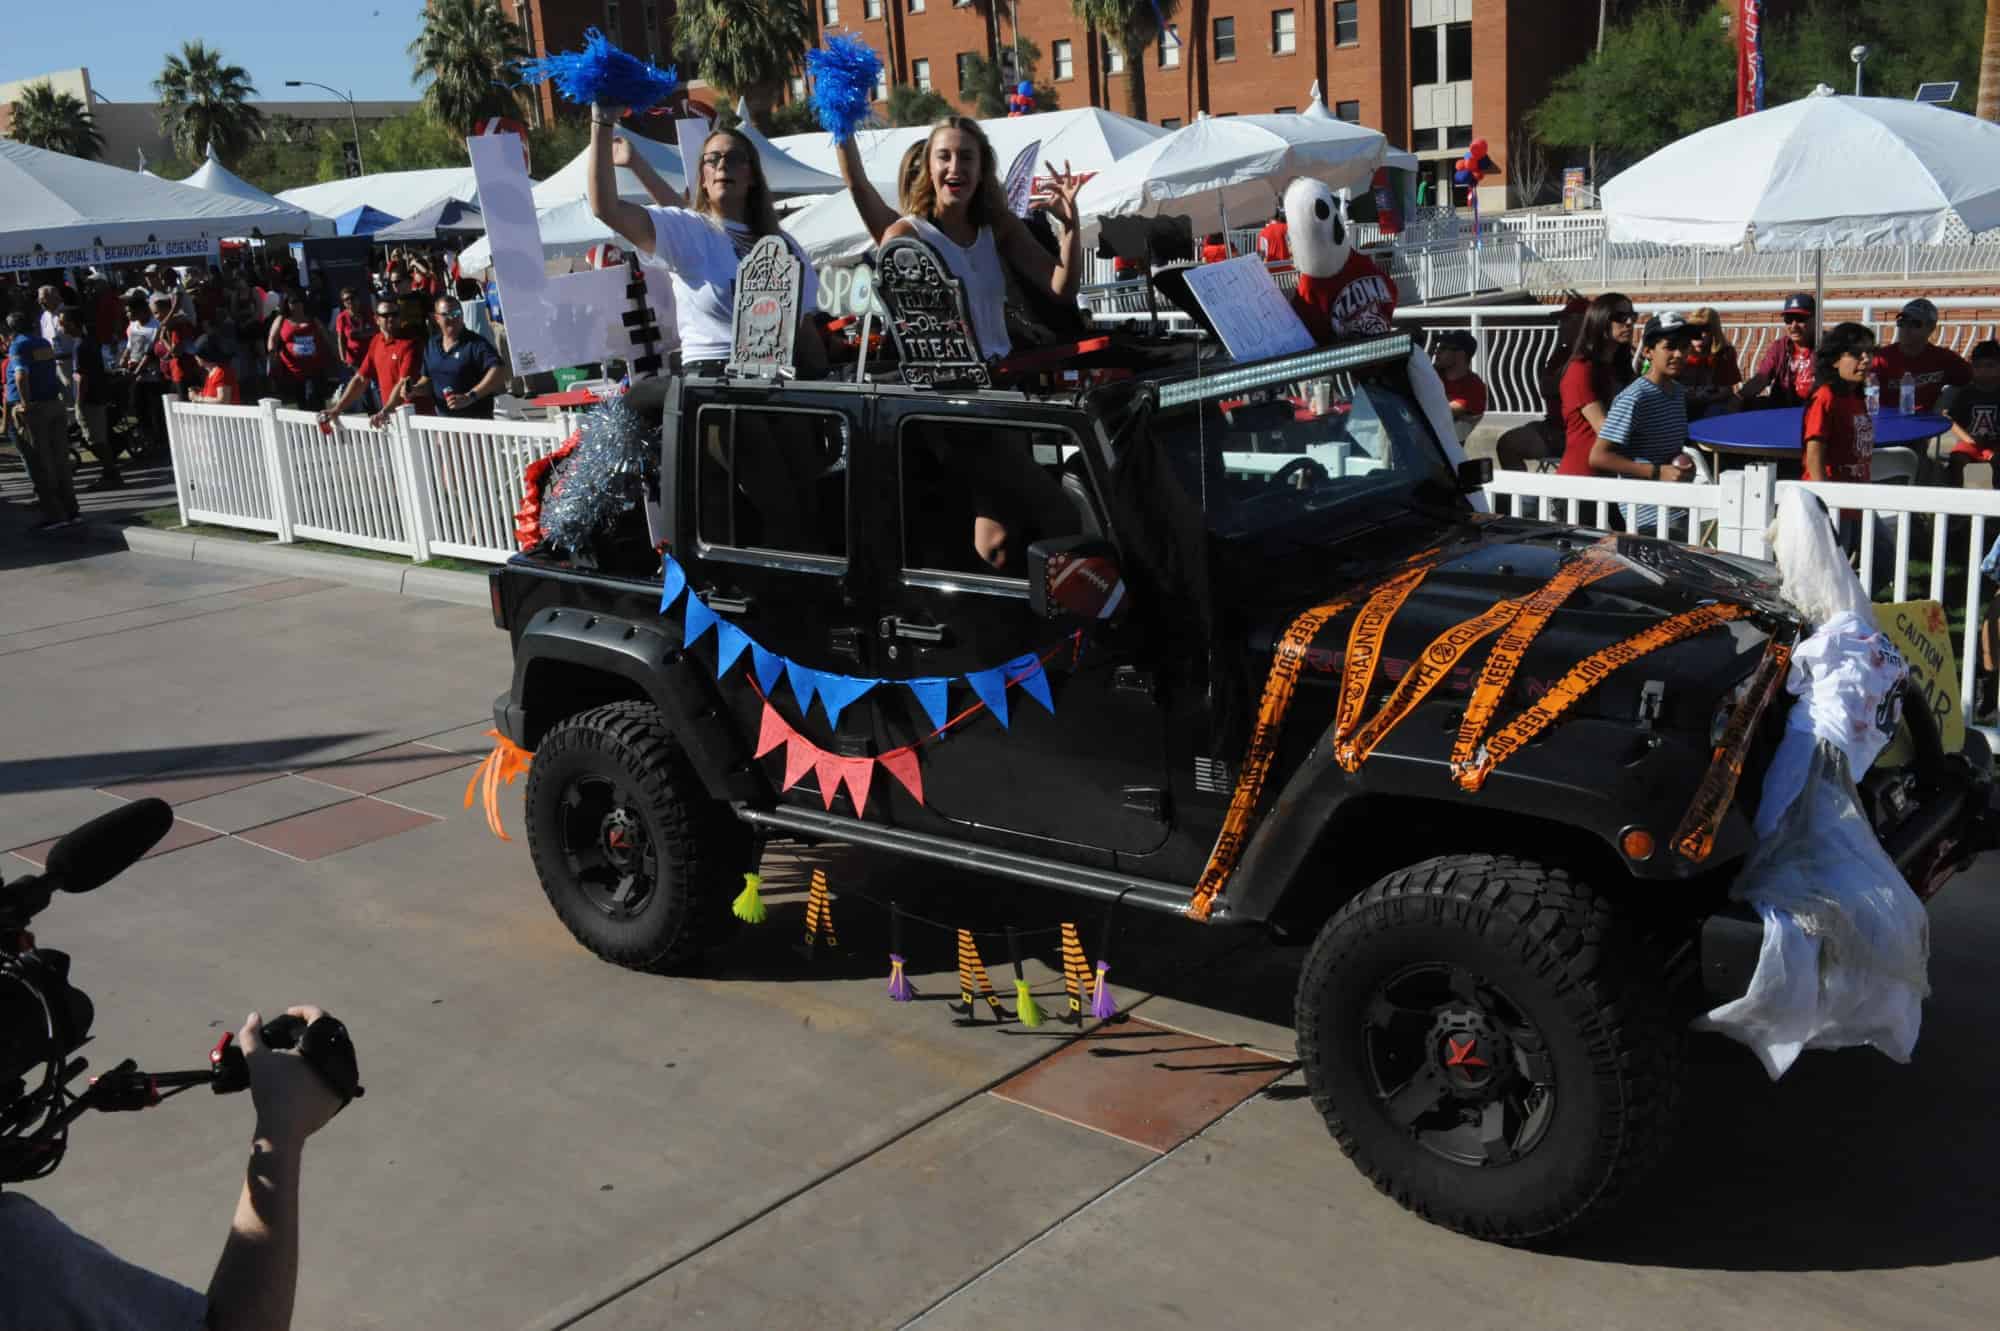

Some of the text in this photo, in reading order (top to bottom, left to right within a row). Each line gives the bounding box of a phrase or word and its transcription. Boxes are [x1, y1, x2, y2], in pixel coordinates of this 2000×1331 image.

[36, 253, 49, 266] OF
[55, 249, 89, 265] SOCIAL
[104, 242, 161, 260] BEHAVIORAL
[165, 238, 208, 257] SCIENCES
[743, 279, 791, 291] BEWARE
[817, 263, 882, 314] SPO
[905, 337, 967, 359] TREAT
[1293, 613, 1323, 645] KEEP
[1354, 610, 1386, 681] HAUNTED
[1896, 613, 1943, 672] CAUTION
[1276, 645, 1299, 682] OUT
[1483, 655, 1514, 687] KEEP
[1503, 632, 1525, 652] OUT
[1575, 660, 1608, 683] OUT
[1514, 706, 1551, 739] KEEP
[1486, 736, 1515, 759] OUT
[1213, 831, 1239, 866] KEEP
